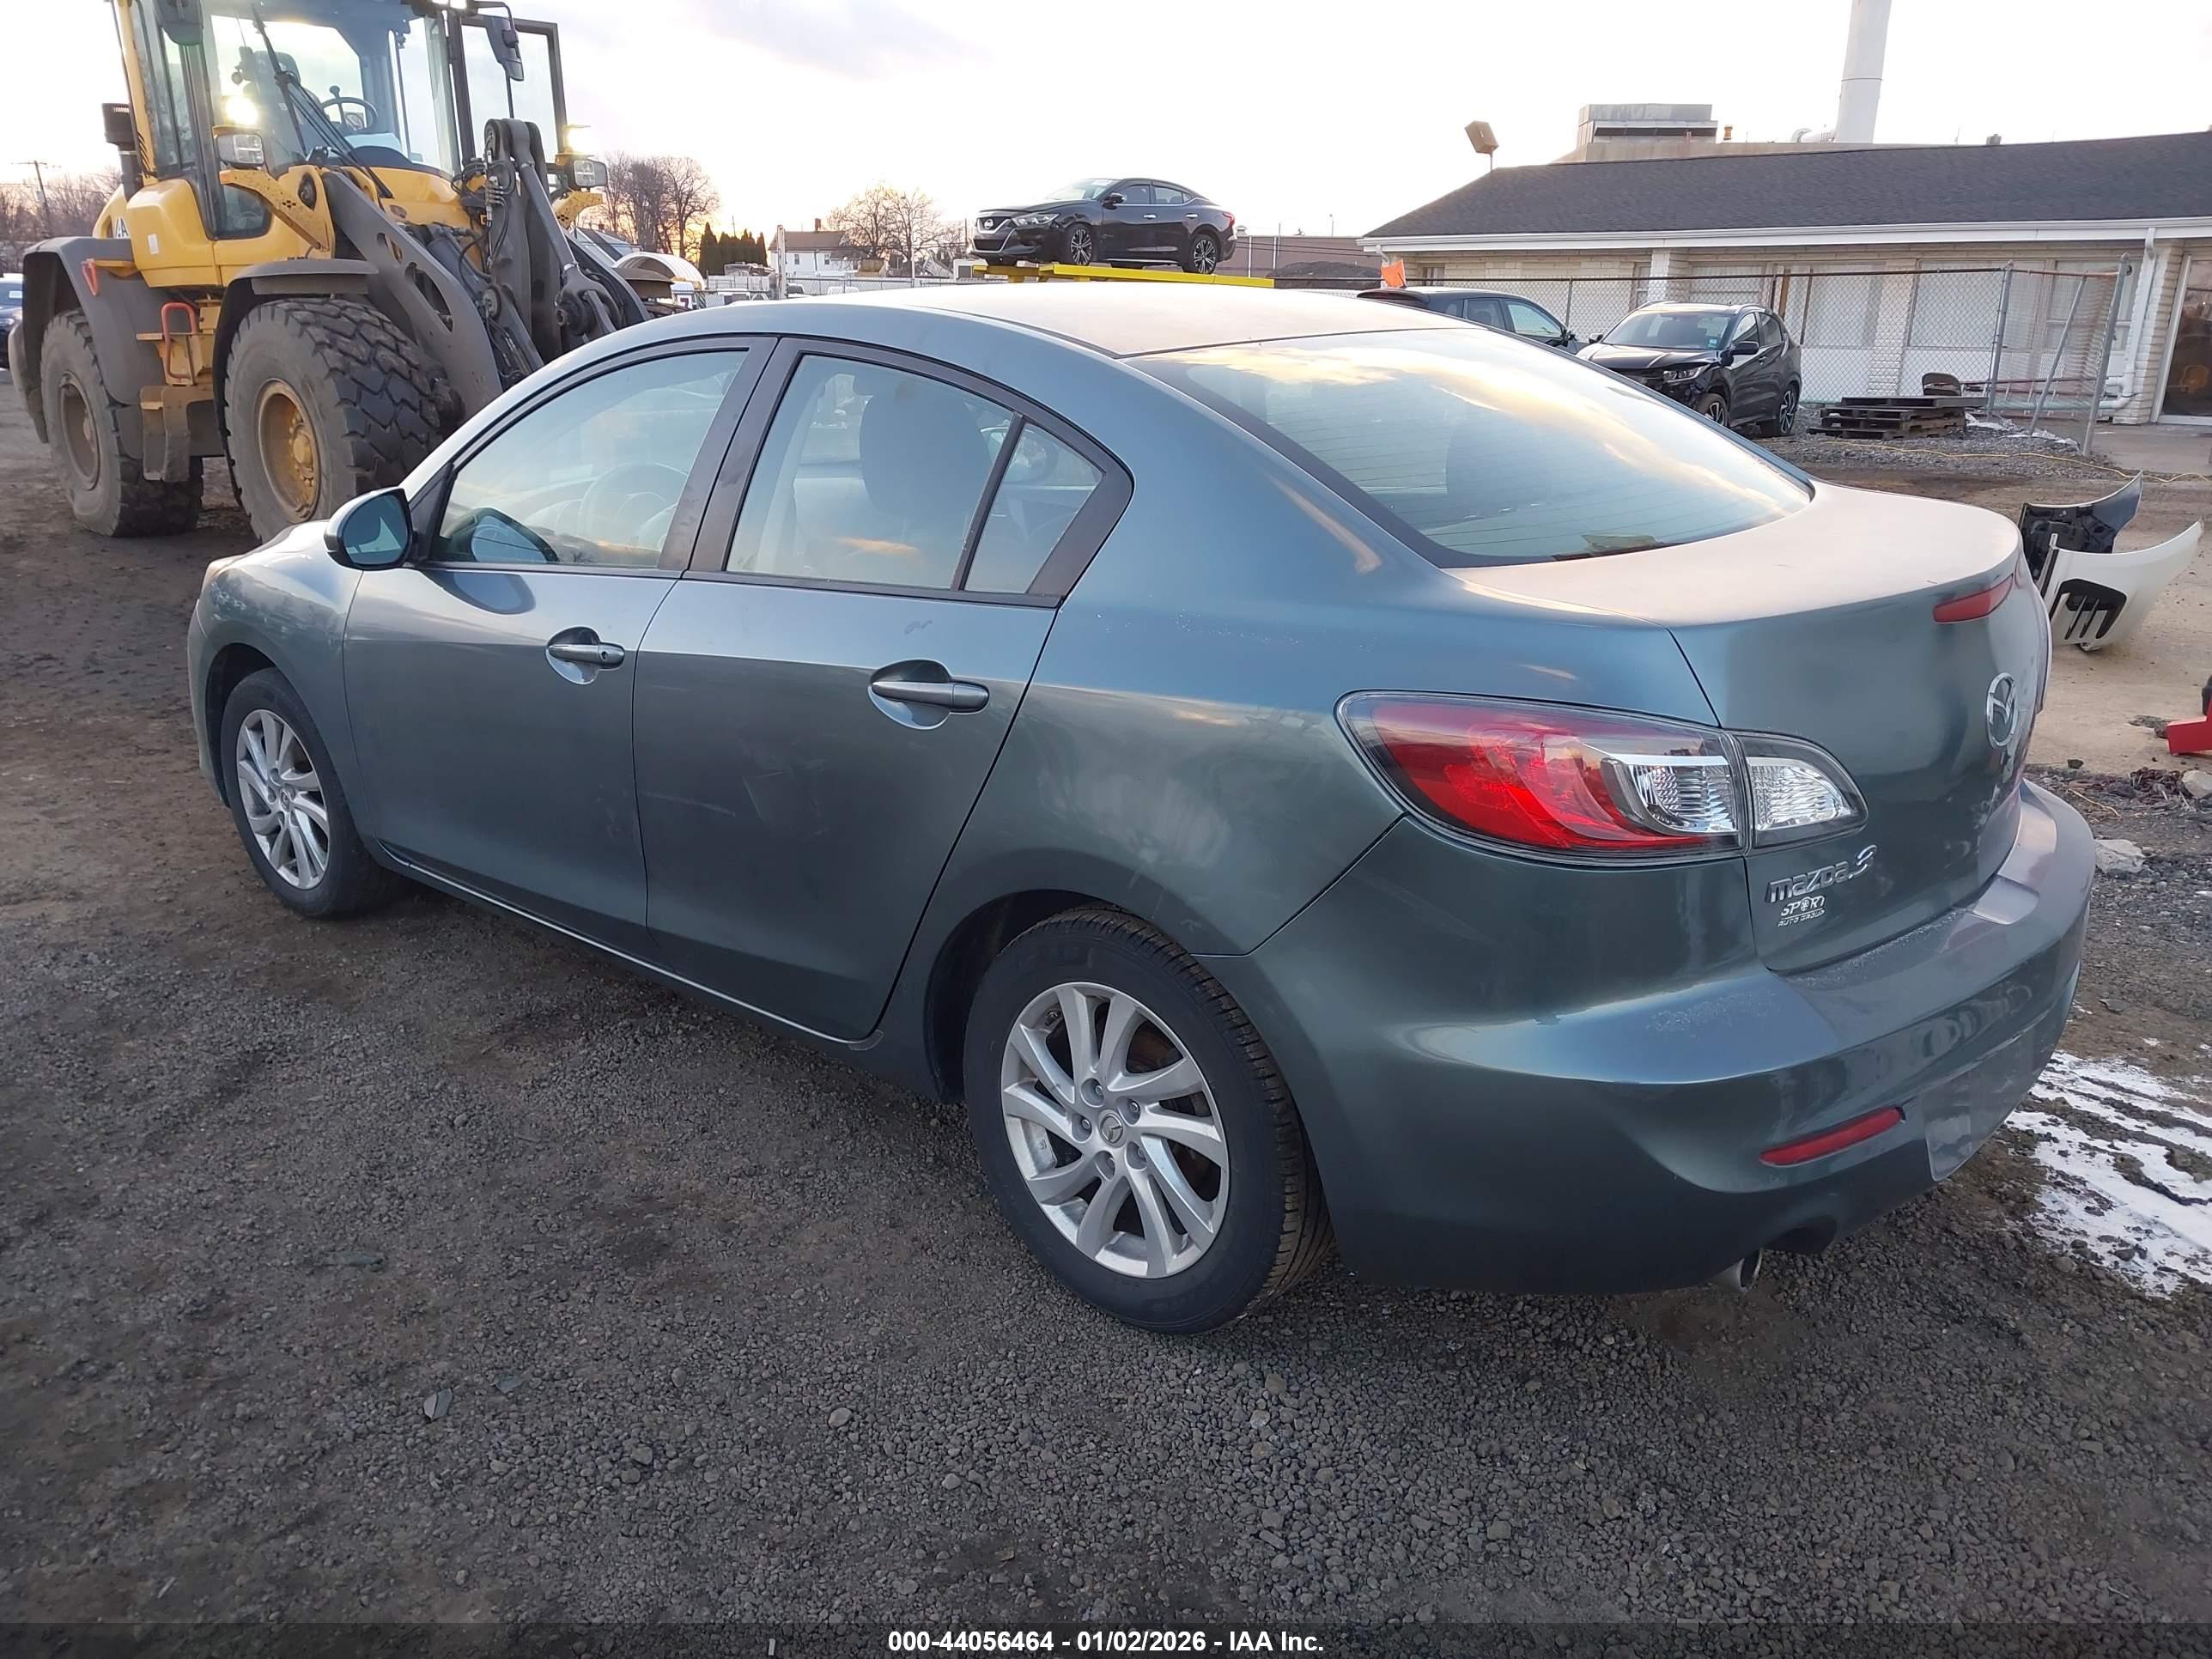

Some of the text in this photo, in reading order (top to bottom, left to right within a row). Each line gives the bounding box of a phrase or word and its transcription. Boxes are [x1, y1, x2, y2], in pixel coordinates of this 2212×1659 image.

[1780, 895, 1825, 916] SPORT
[1778, 909, 1825, 927] AUTO GROUP
